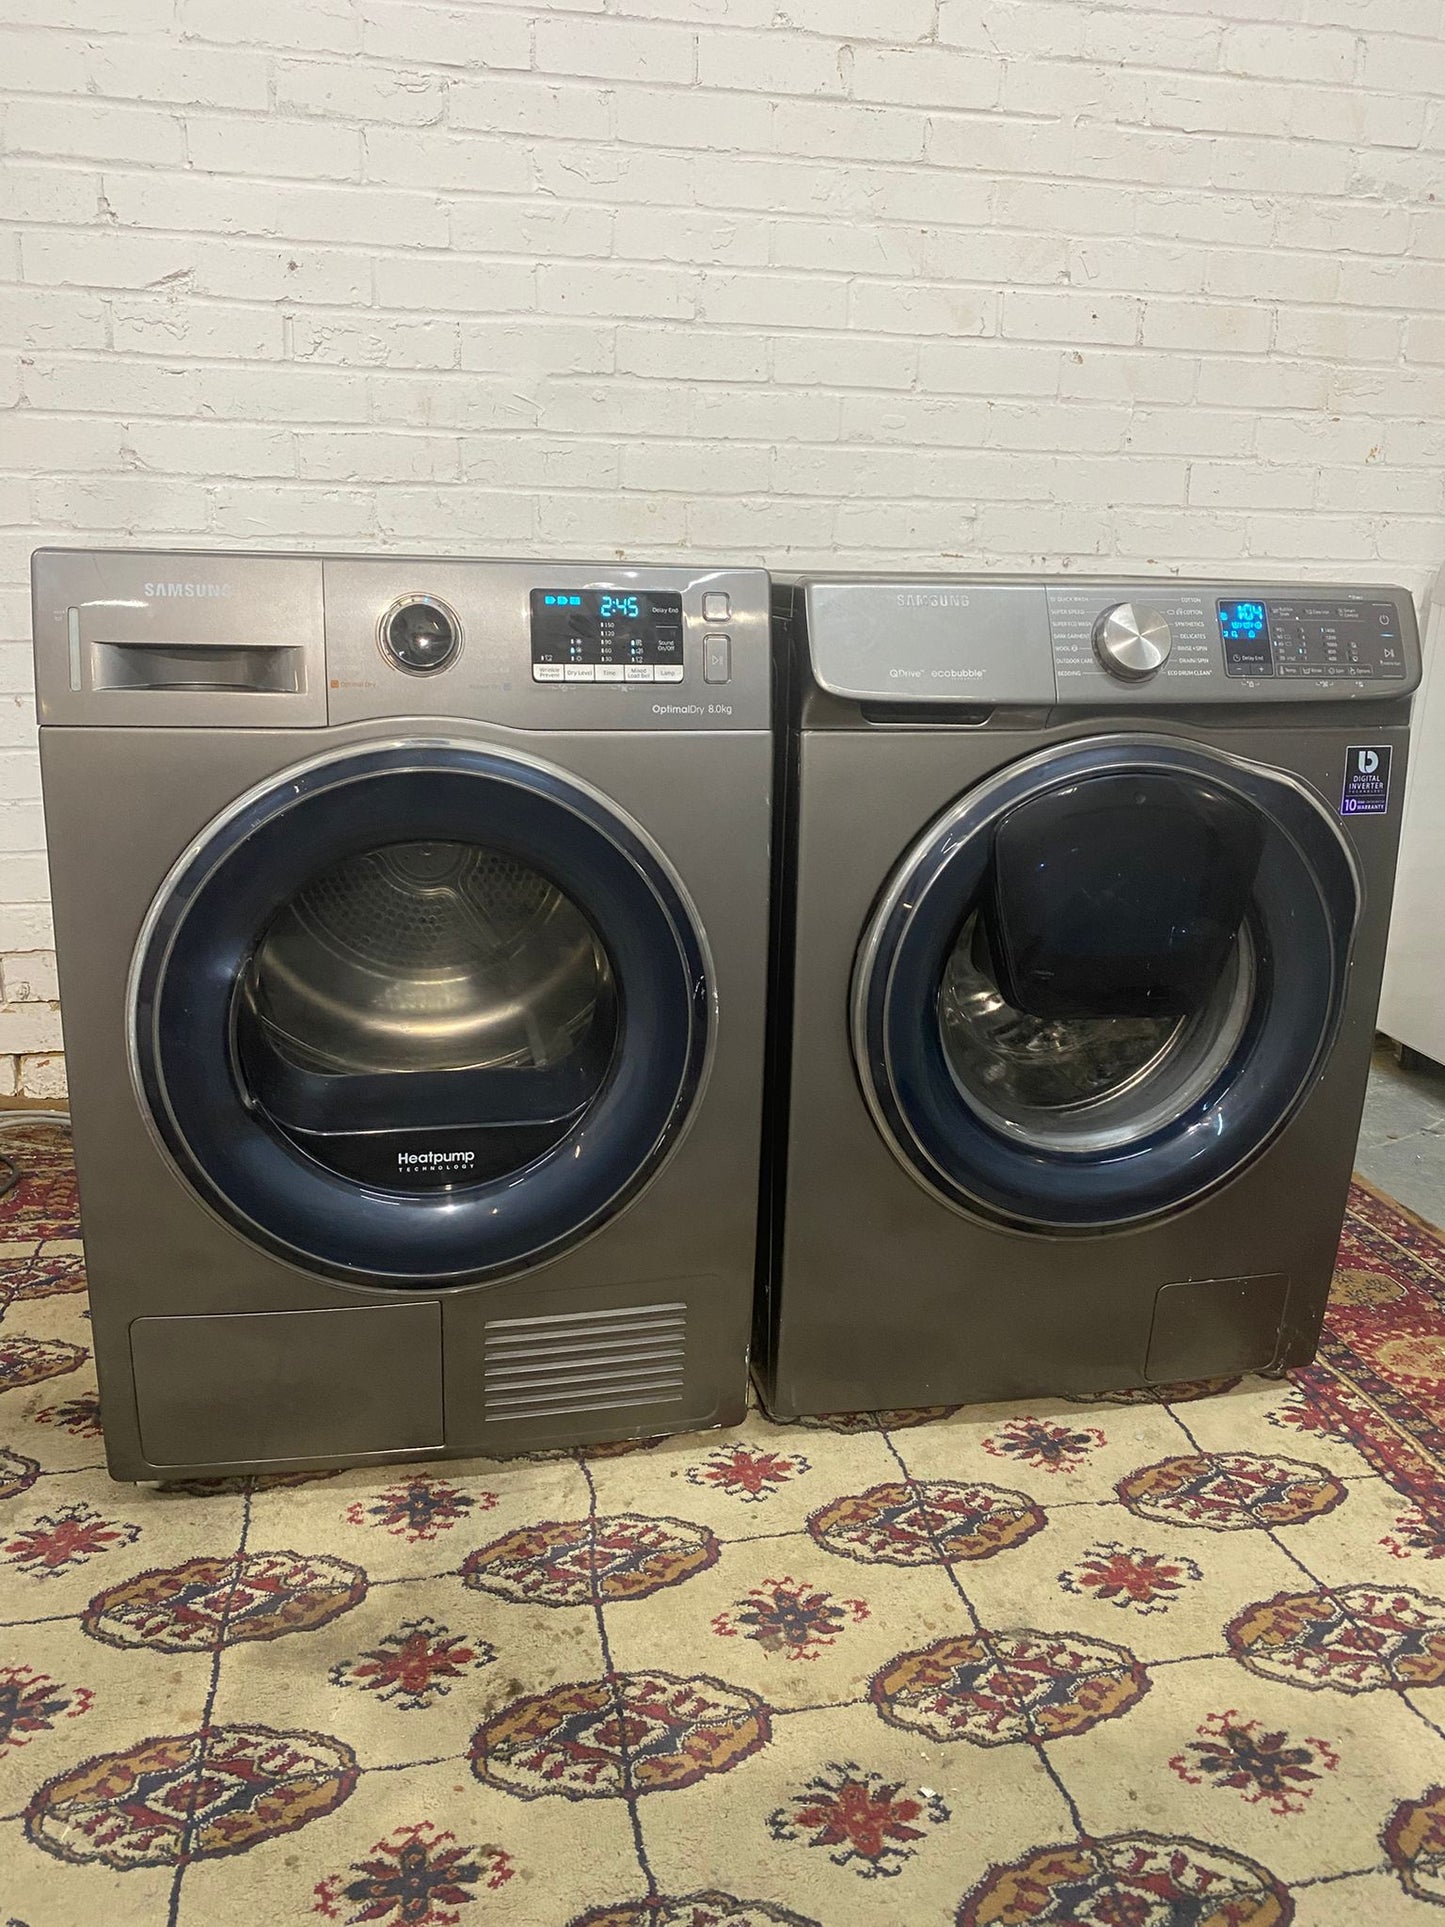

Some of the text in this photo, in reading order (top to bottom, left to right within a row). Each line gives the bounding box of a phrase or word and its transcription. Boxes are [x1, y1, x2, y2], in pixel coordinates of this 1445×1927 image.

[601, 596, 639, 617] 2:45
[652, 607, 668, 615] Delay
[708, 704, 732, 715] 8.0kg
[1349, 782, 1384, 790] INVERTER
[1345, 798, 1357, 811] 10
[398, 1151, 475, 1165] Heatpump
[398, 1164, 475, 1173] TECHNOLOGY
